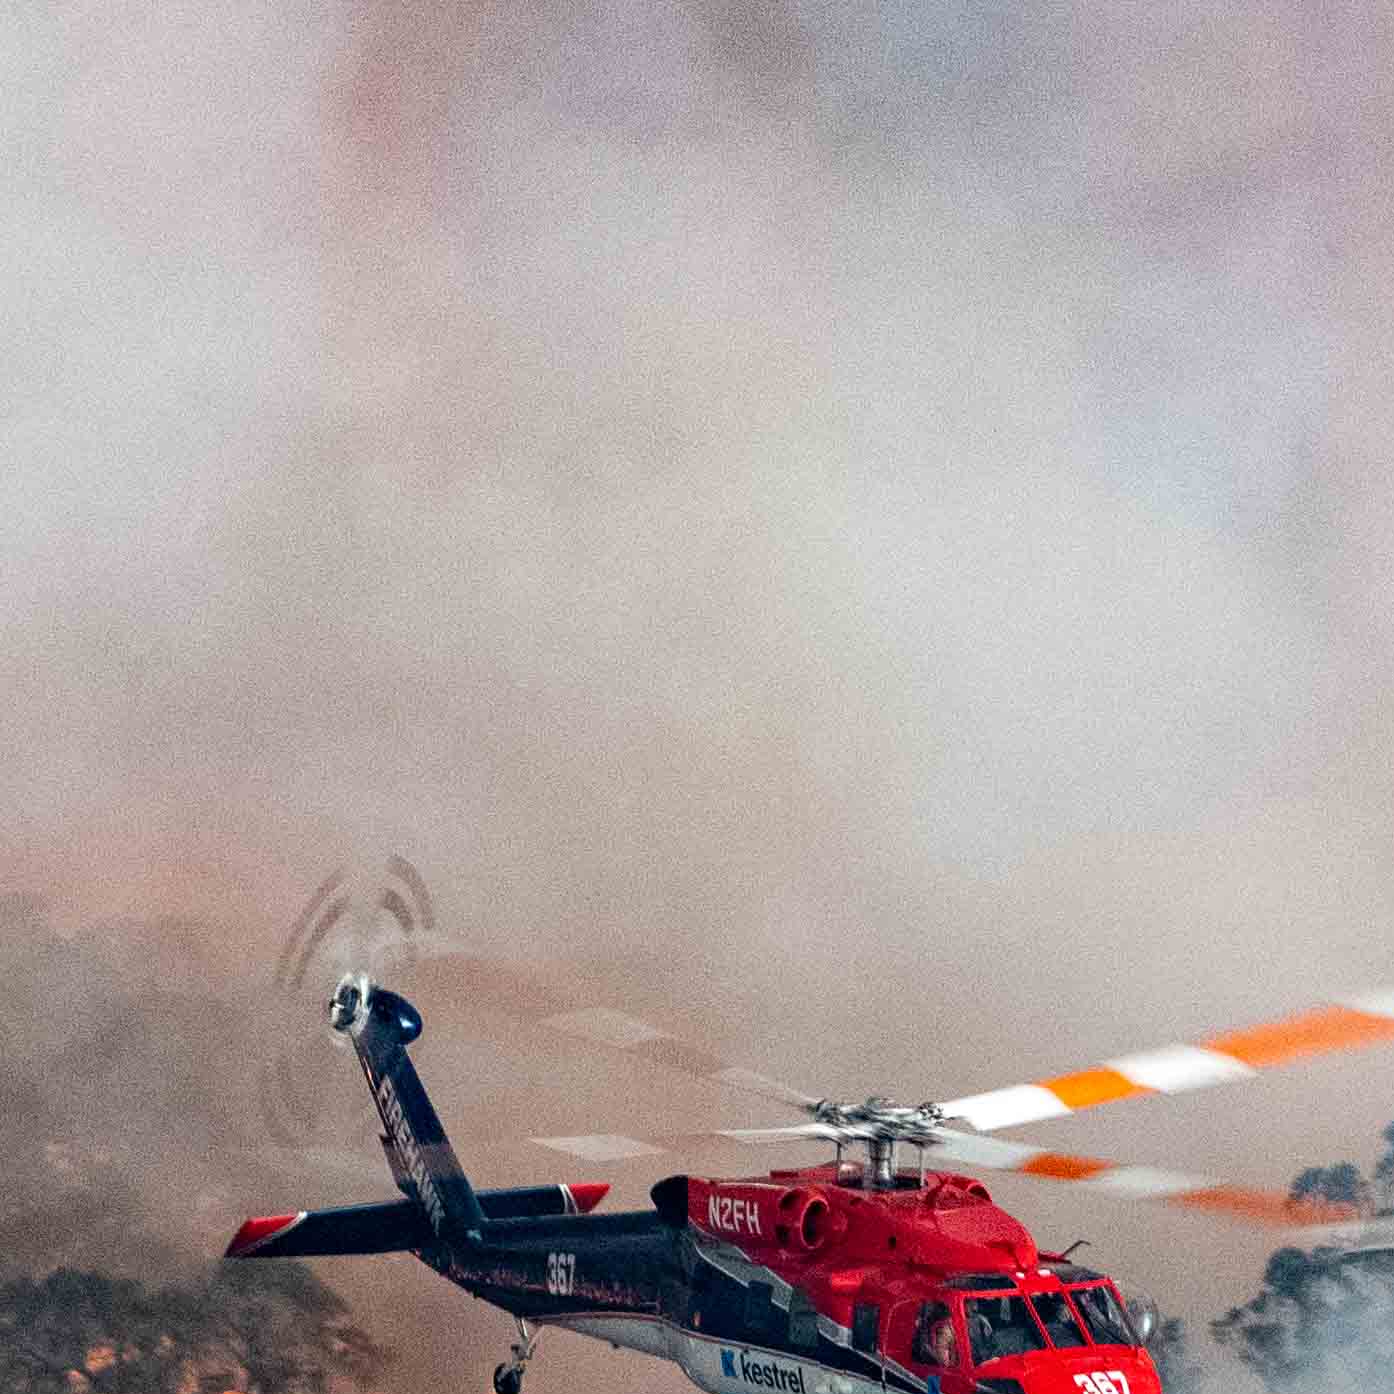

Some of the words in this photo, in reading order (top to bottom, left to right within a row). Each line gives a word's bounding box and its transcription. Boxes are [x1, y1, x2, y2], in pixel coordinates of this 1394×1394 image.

[708, 1194, 762, 1235] N2FH
[547, 1253, 576, 1297] 367
[740, 1354, 806, 1394] kestrel
